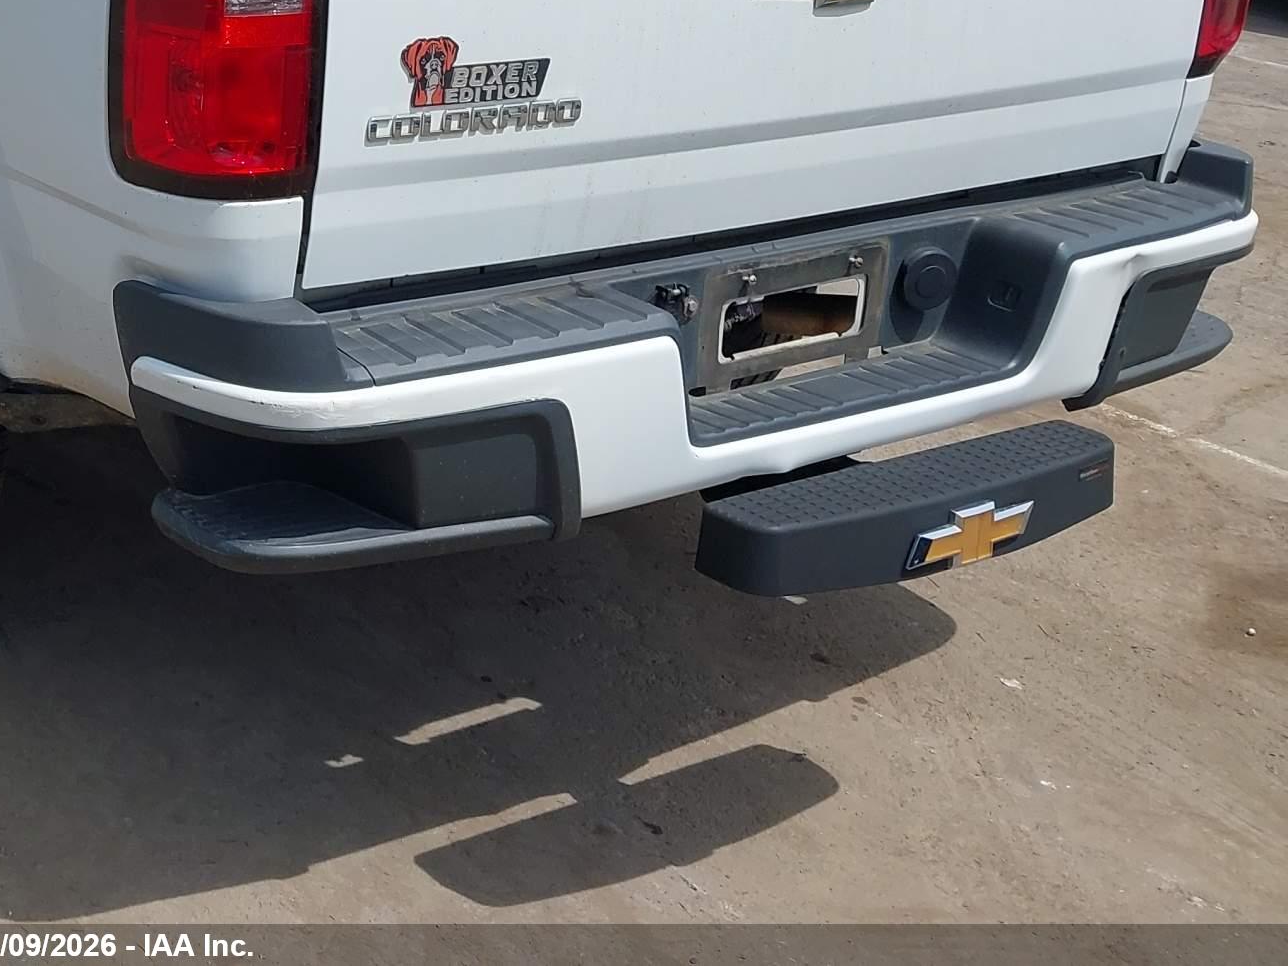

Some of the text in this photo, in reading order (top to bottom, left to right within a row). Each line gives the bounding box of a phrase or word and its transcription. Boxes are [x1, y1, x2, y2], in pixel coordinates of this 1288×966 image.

[451, 61, 540, 88] BOXER
[444, 81, 537, 104] EDITION
[366, 97, 582, 144] COLORADO
